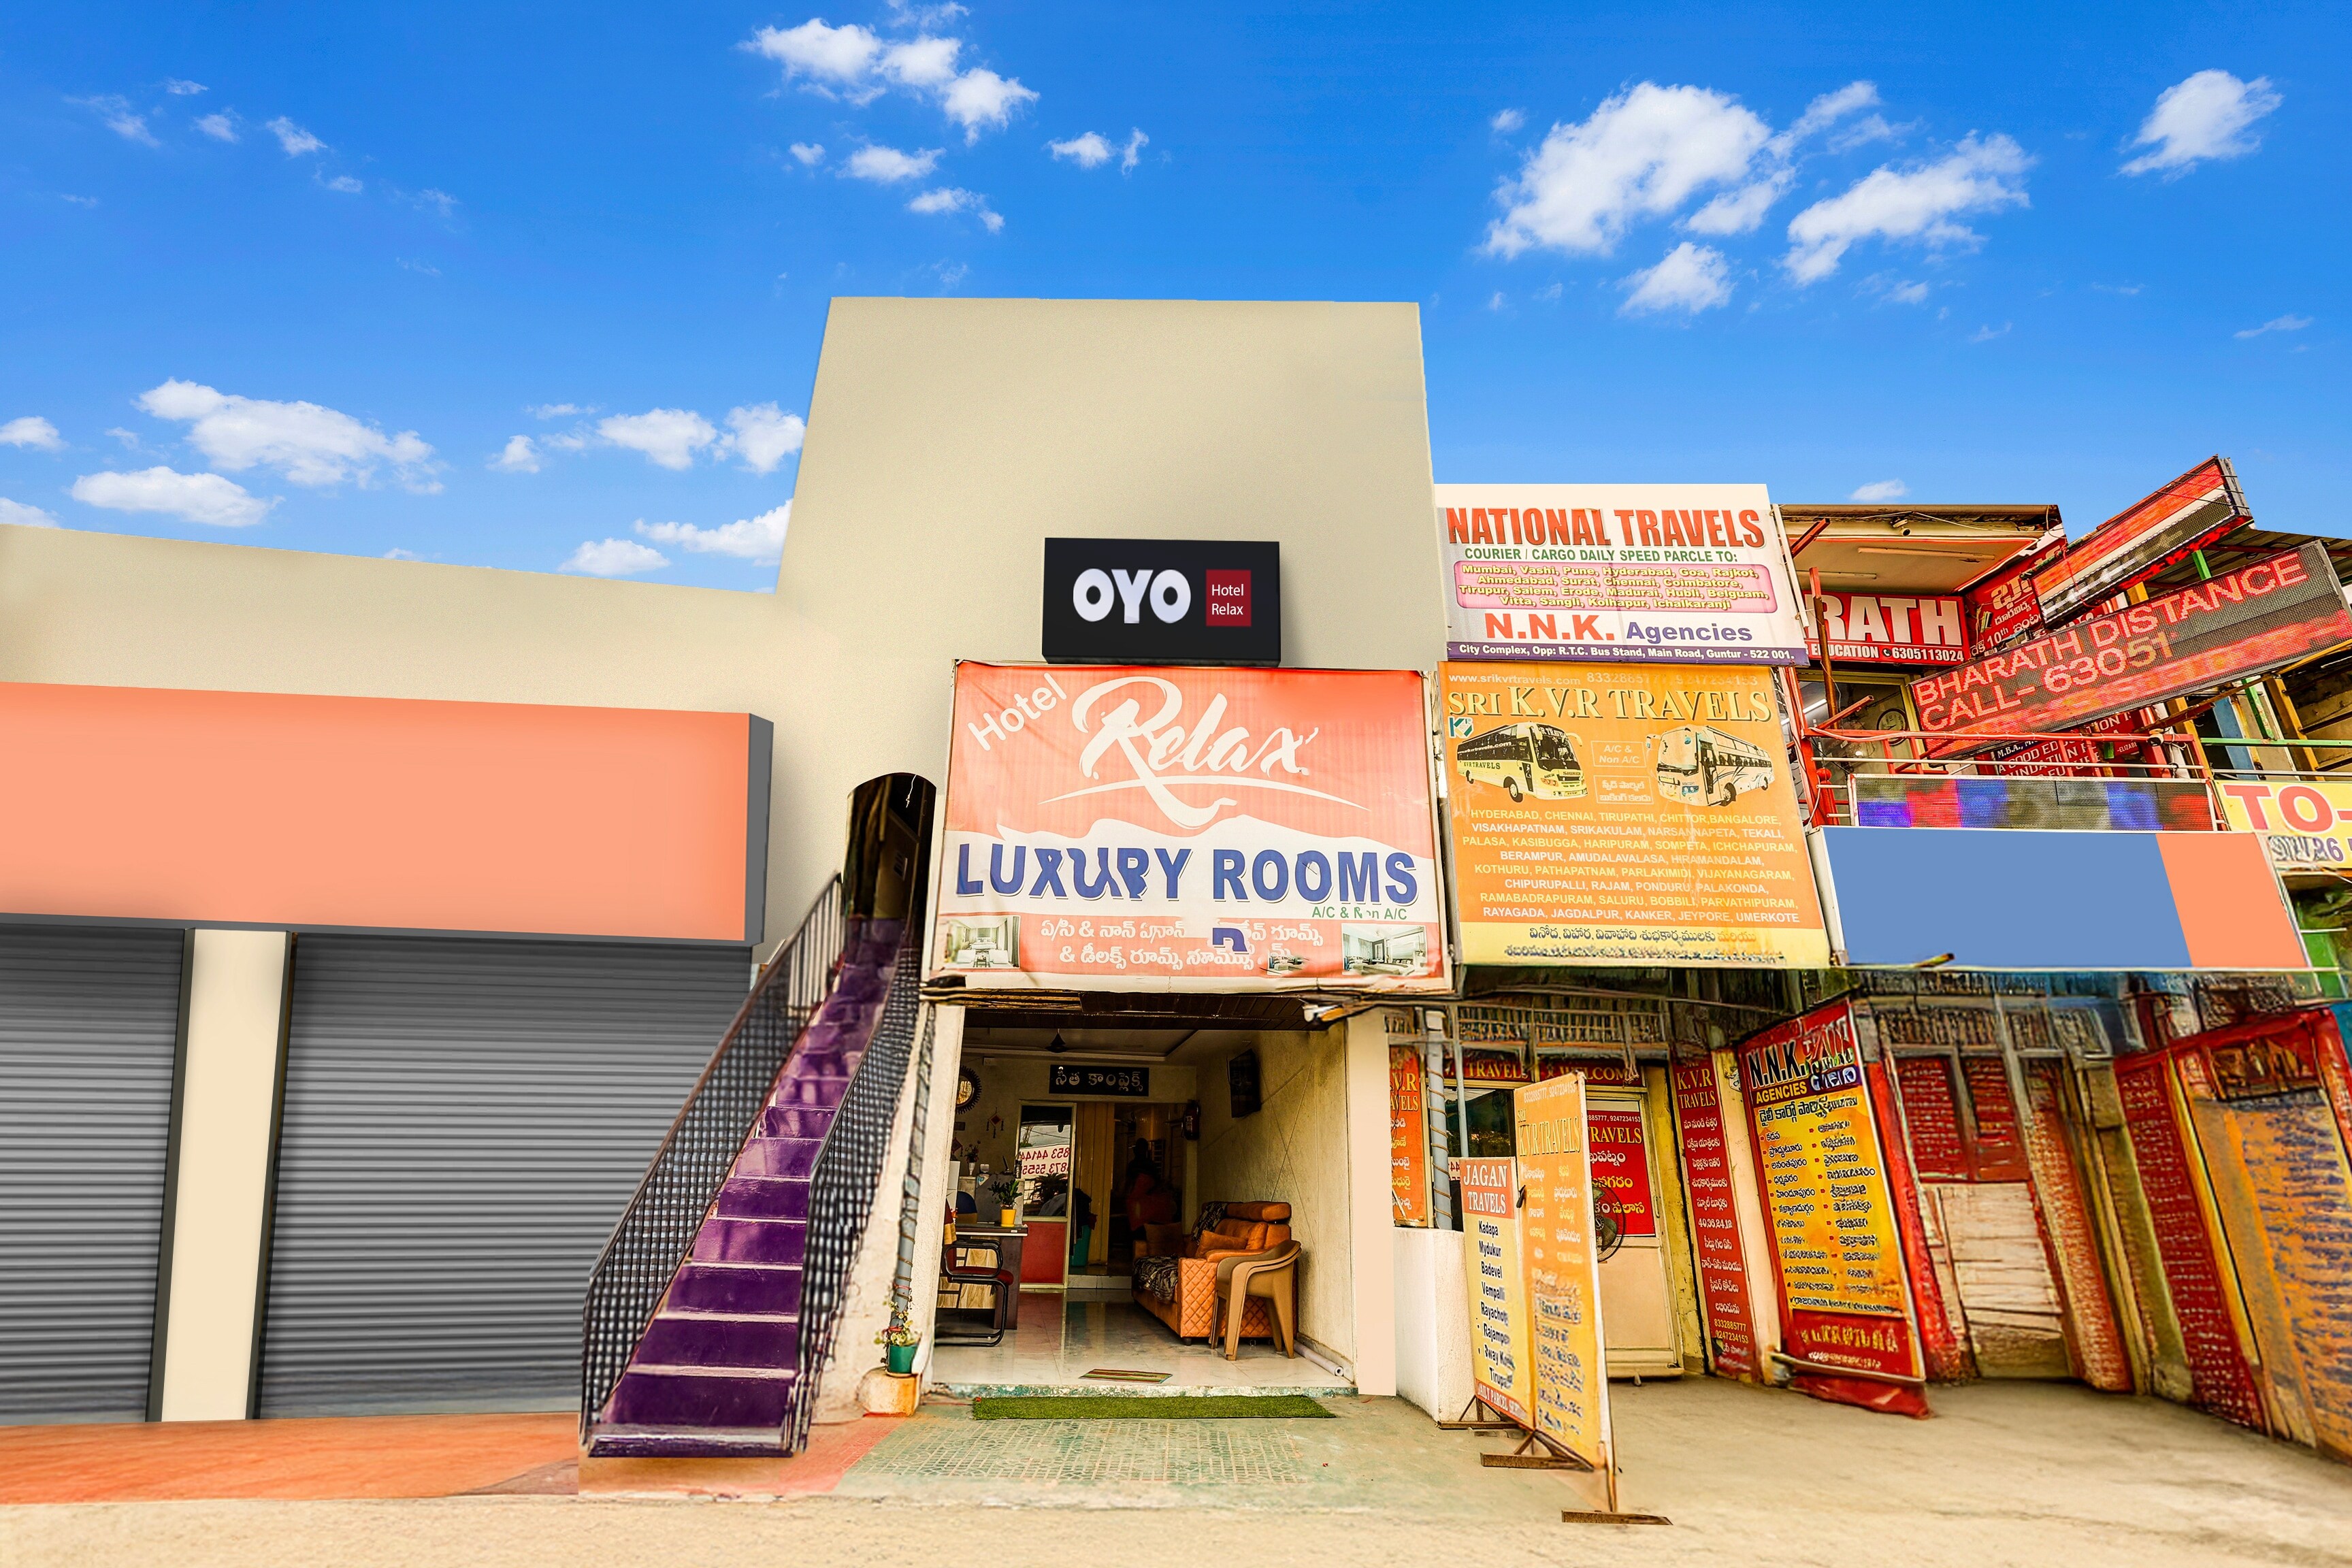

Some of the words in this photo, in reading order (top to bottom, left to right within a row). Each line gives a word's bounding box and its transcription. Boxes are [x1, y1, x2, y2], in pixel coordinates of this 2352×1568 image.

[1446, 508, 1612, 545] NATIONAL
[1614, 510, 1765, 548] TRAVELS
[1465, 548, 1522, 559] COURIER
[1532, 549, 1575, 560] CARGO
[1580, 550, 1615, 561] DAILY
[1620, 550, 1661, 561] SPEED
[1665, 551, 1713, 562] PARCLE
[1716, 551, 1737, 562] TO:
[1462, 565, 1516, 575] Mumbai,
[1520, 566, 1559, 576] Vashi,
[1563, 566, 1599, 576] Pune,
[1602, 567, 1676, 578] Hyderabad,
[1679, 568, 1710, 578] Goa,
[1712, 568, 1759, 578] Rajkot,
[1211, 583, 1244, 596] Hotel
[1477, 576, 1558, 586] Ahmedabad,
[1561, 577, 1600, 587] Surat,
[1603, 578, 1661, 588] Chennai,
[1663, 578, 1743, 589] Coimbatore,
[1073, 568, 1192, 623] OYO
[1458, 585, 1509, 595] Tirupur,
[1513, 587, 1557, 596] Salem,
[1561, 587, 1603, 597] Erode,
[1606, 588, 1663, 599] Madurai,
[1666, 589, 1704, 598] Hubli,
[1708, 589, 1769, 600] Belguam,
[1211, 603, 1243, 615] Relax
[1499, 597, 1536, 606] Vitta,
[1539, 598, 1584, 608] Sangli,
[1588, 598, 1650, 609] Kolhapur,
[1653, 599, 1731, 610] Ichalkaranji
[1484, 613, 1614, 640] N.N.K.
[1627, 621, 1753, 644] Agencies
[1916, 632, 2085, 706] BHARATH
[2089, 552, 2308, 648] DISTANCE
[1459, 644, 1480, 655] City
[1482, 645, 1531, 656] Complex,
[1532, 646, 1556, 656] Opp:
[1558, 647, 1588, 656] R.T.C.
[1590, 647, 1611, 656] Bus
[1612, 648, 1646, 658] Stand,
[1648, 649, 1673, 657] Main
[1675, 649, 1705, 659] Road,
[1707, 649, 1742, 658] Guntur
[1750, 649, 1770, 659] 522
[1771, 650, 1795, 659] 001.
[1891, 647, 1964, 662] 6305113024
[1448, 674, 1581, 685] www.srikvrtravels.com
[967, 672, 1067, 751] Hotel
[1448, 691, 1502, 717] SRI
[1507, 686, 1603, 718] K.V.R
[1608, 688, 1774, 722] TRAVELS
[1072, 676, 1320, 829] Relax
[1603, 745, 1622, 753] A/C
[1471, 809, 1542, 821] HYDERABAD,
[1545, 811, 1597, 822] CHENNAI,
[1599, 812, 1657, 823] TIRUPATHI,
[1471, 823, 1567, 835] VISAKHAPATNAM,
[1570, 826, 1646, 836] SRIKAKULAM,
[1648, 827, 1740, 838] NARSANNAPETA,
[1742, 828, 1784, 840] TEKALI,
[1463, 836, 1509, 848] PALASA,
[1512, 837, 1581, 849] KASIBUGGA,
[1584, 839, 1652, 850] HARIPURAM,
[1655, 840, 1710, 852] SOMPETA,
[1714, 842, 1797, 853] ICHCHAPURAM,
[1500, 851, 1566, 862] BERAMPUR,
[1569, 853, 1669, 865] AMUDALAVALASA,
[1671, 855, 1765, 866] HIRAMANDALAM,
[1212, 848, 1420, 906] ROOMS
[1474, 864, 1532, 876] KOTHURU,
[1535, 866, 1619, 878] PATHAPATNAM,
[1622, 868, 1695, 879] PARLAKIMIDI,
[1697, 869, 1795, 881] VIJAYANAGARAM,
[1505, 879, 1589, 891] CHIPURUPALLI,
[1591, 881, 1633, 892] RAJAM,
[1697, 883, 1769, 894] PALAKONDA,
[1480, 892, 1596, 906] RAMABADRAPURAM,
[1599, 895, 1648, 906] SALURU,
[1650, 896, 1698, 908] BOBBILI,
[1701, 898, 1798, 909] PARVATHIPURAM,
[1312, 906, 1335, 918] A/C
[1340, 906, 1349, 918] &
[1384, 908, 1407, 920] A/C
[1483, 907, 1548, 919] RAYAGADA,
[1551, 909, 1622, 921] JAGDALPUR,
[1625, 910, 1676, 921] KANKER,
[1678, 911, 1733, 923] JEYPORE,
[1736, 913, 1800, 923] UMERKOTE
[1747, 1040, 1807, 1089] N.N.K.
[1677, 1067, 1713, 1090] K.V.R
[1678, 1090, 1716, 1109] TRAVELS
[1756, 1081, 1808, 1105] AGENCIES
[1610, 1115, 1641, 1123] 9247234153
[1539, 1116, 1581, 1154] TRAVELS
[1588, 1126, 1642, 1144] RAVELS
[1464, 1164, 1507, 1188] JAGAN
[1467, 1191, 1506, 1214] TRAVELS
[1478, 1220, 1499, 1238] Kadapa
[1479, 1240, 1501, 1257] Mydukur
[1481, 1260, 1503, 1279] Badevel
[1714, 1318, 1746, 1332] 8332885777
